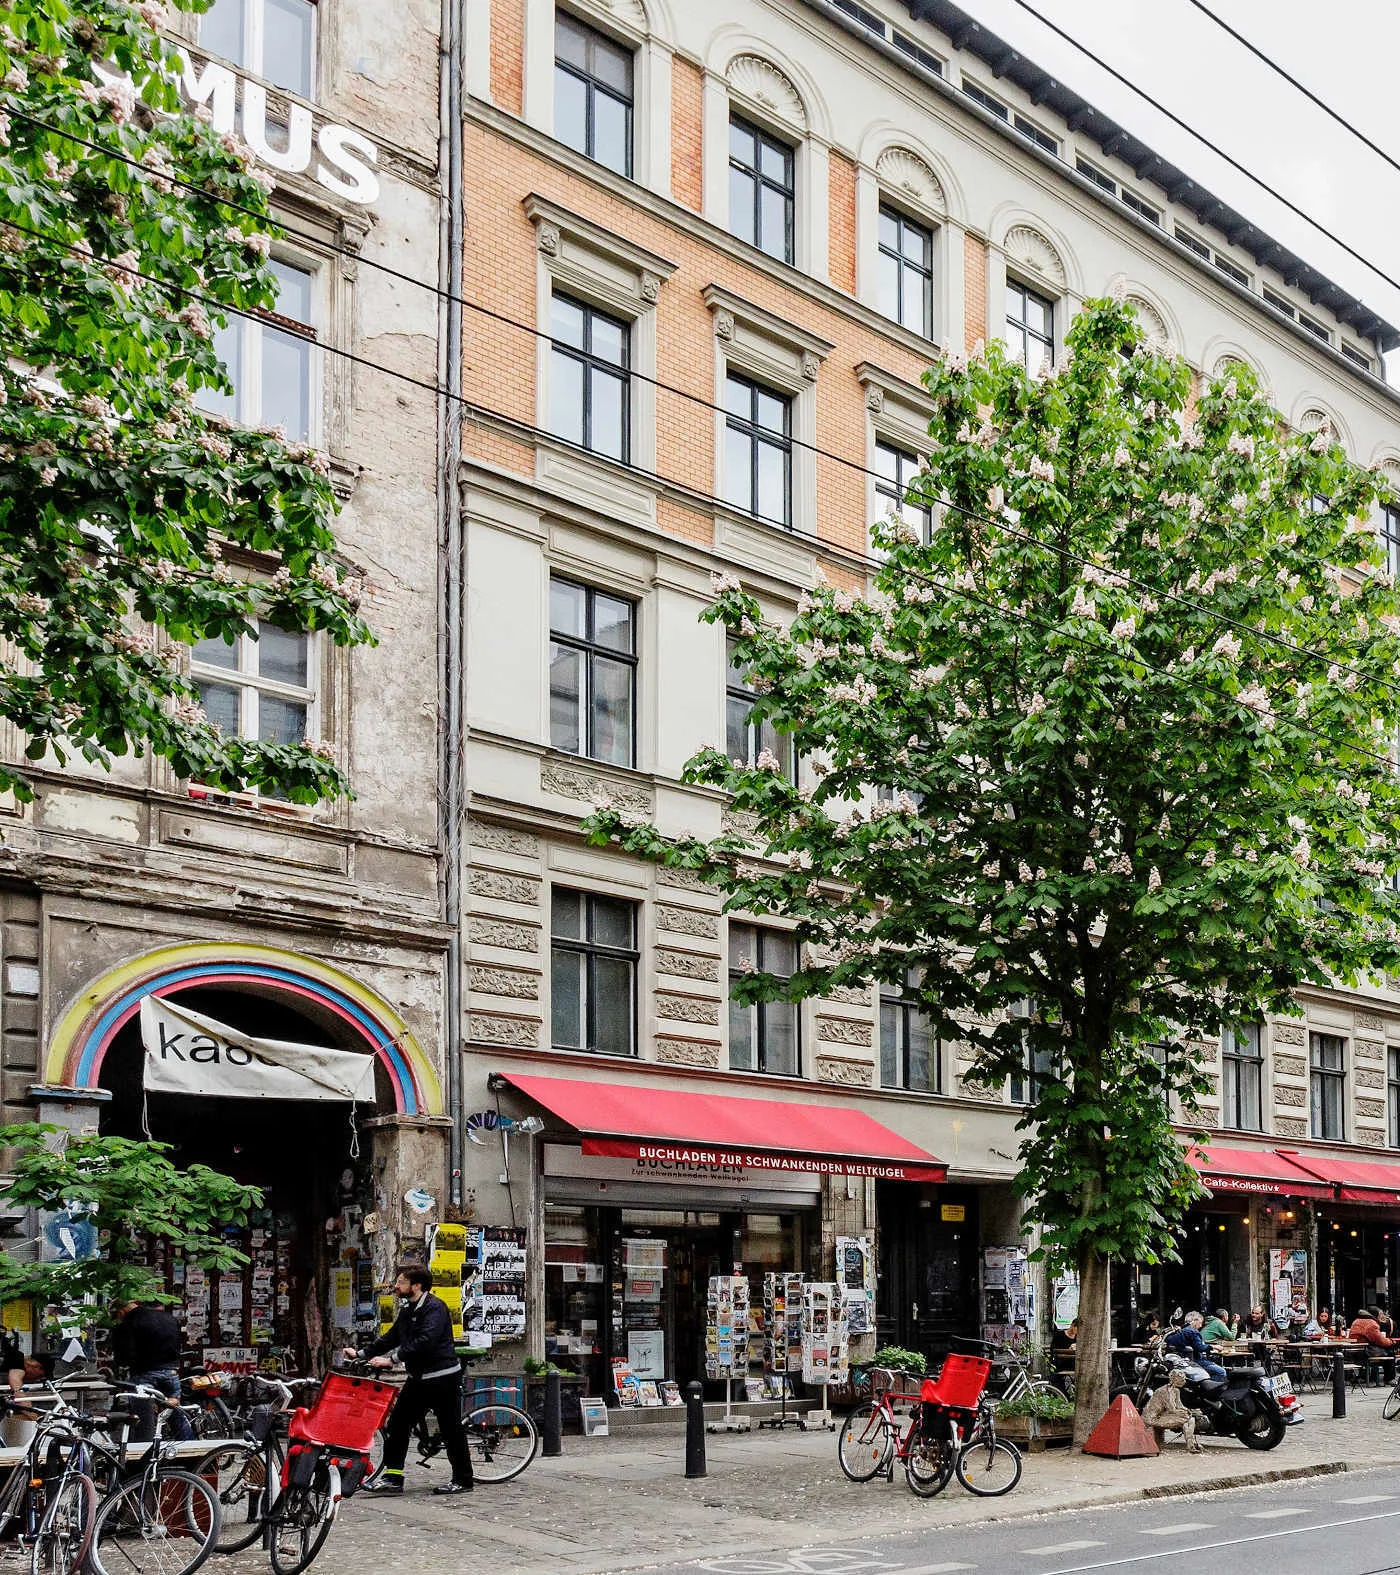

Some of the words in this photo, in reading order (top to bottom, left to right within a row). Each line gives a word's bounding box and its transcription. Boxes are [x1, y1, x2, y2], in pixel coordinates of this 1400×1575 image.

[158, 1021, 281, 1067] kao
[638, 1147, 716, 1164] BUCHLADEN
[720, 1153, 742, 1165] ZUR
[746, 1155, 843, 1174] SCHWANKENDEN
[846, 1164, 905, 1178] WELTKUGEL
